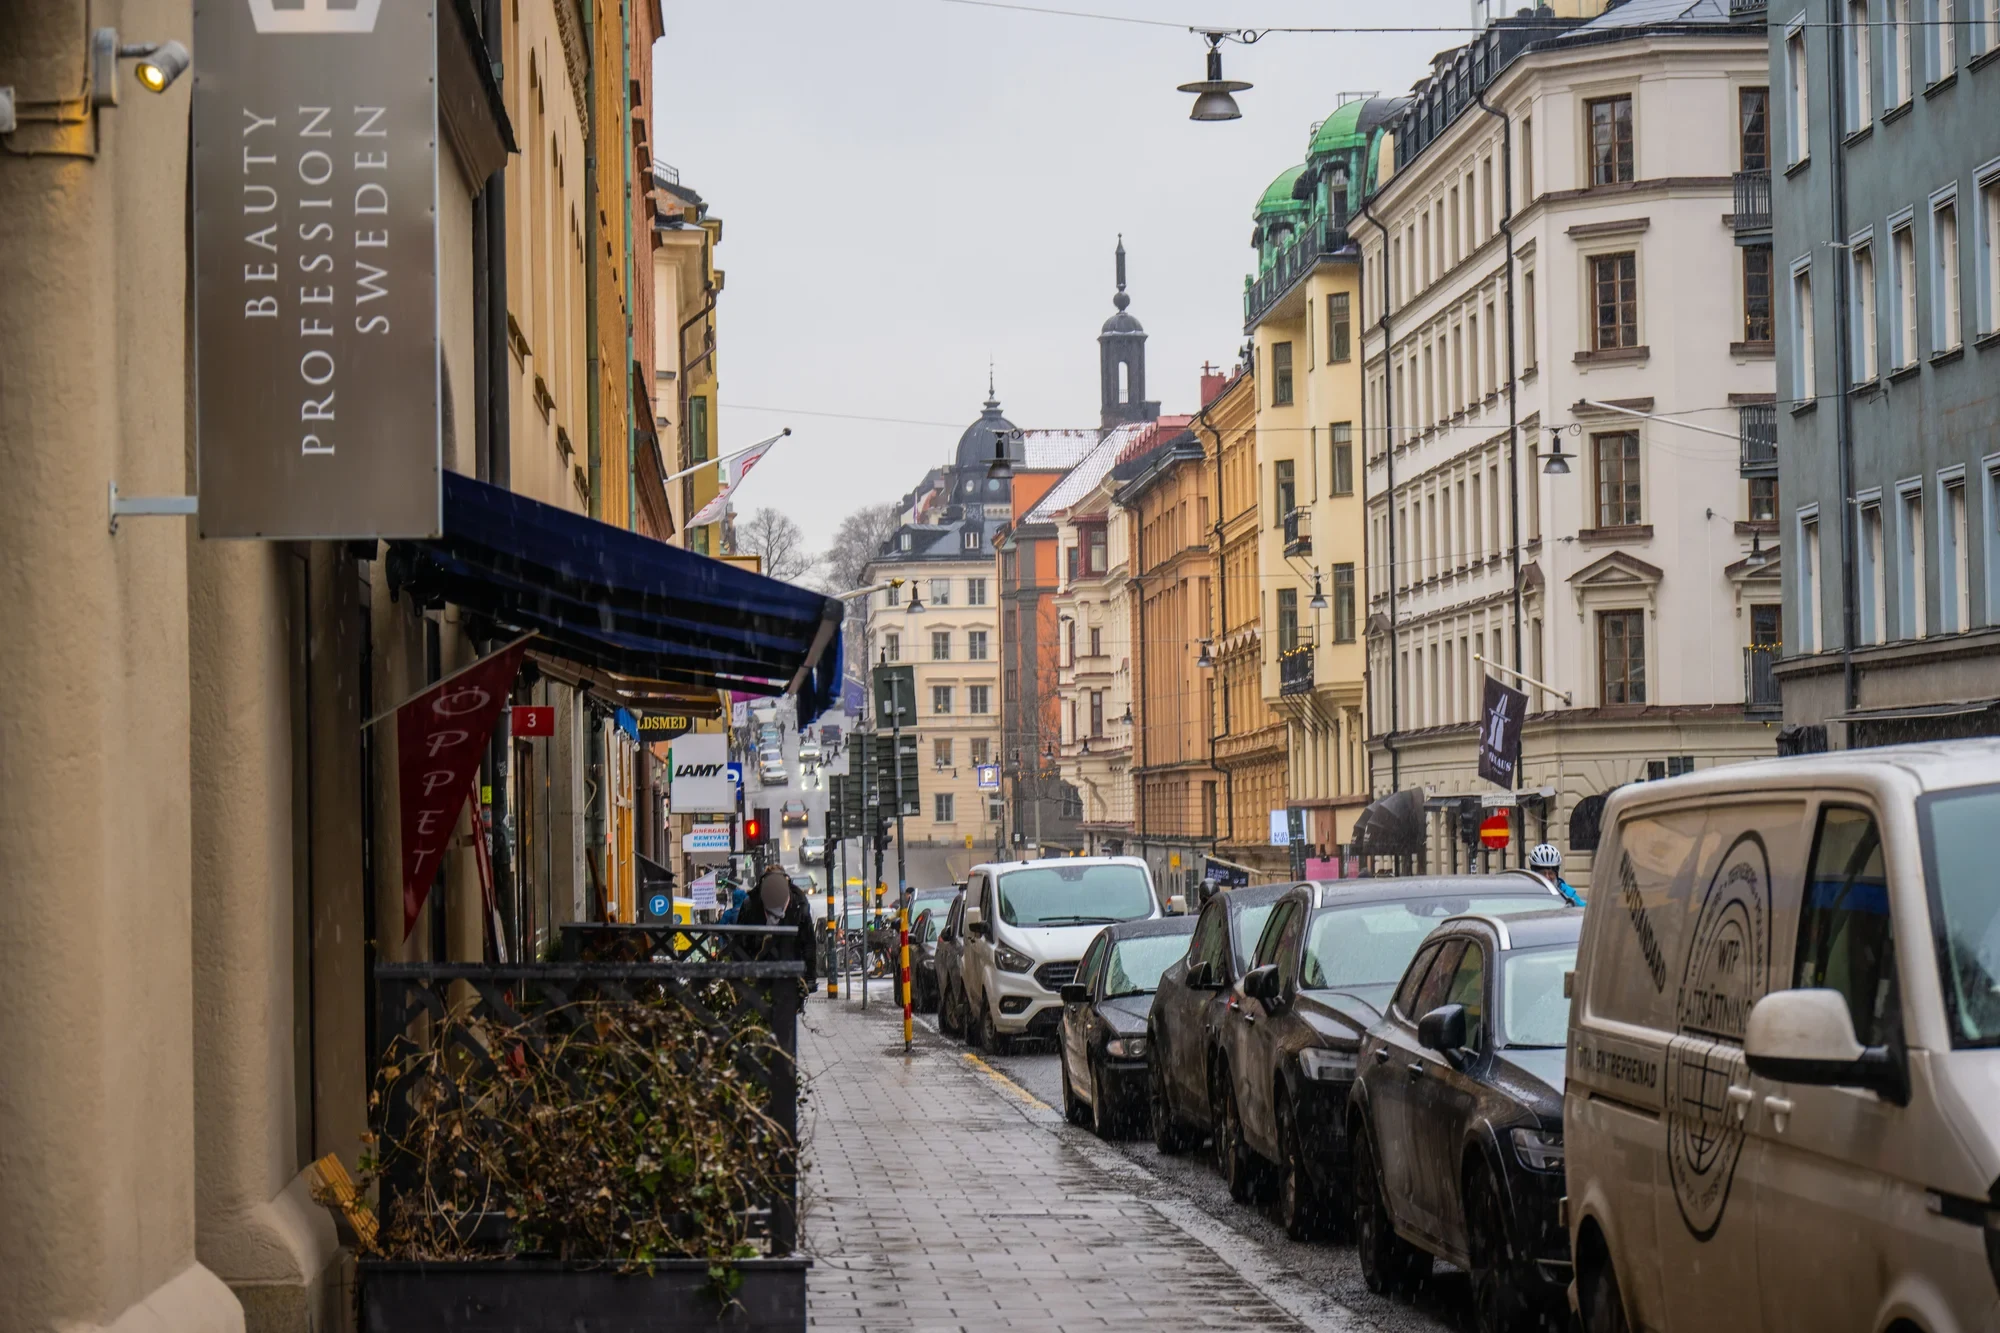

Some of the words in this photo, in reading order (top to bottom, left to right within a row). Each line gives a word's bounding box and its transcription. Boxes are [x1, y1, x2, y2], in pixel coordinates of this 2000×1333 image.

[244, 107, 278, 319] BEAUTY
[355, 105, 389, 334] SWEDEN
[299, 105, 335, 456] PROFESSION
[527, 713, 537, 728] 3
[675, 764, 724, 777] LAMY
[412, 686, 491, 875] ÖPPET
[654, 899, 665, 912] P
[1719, 939, 1740, 975] WTP
